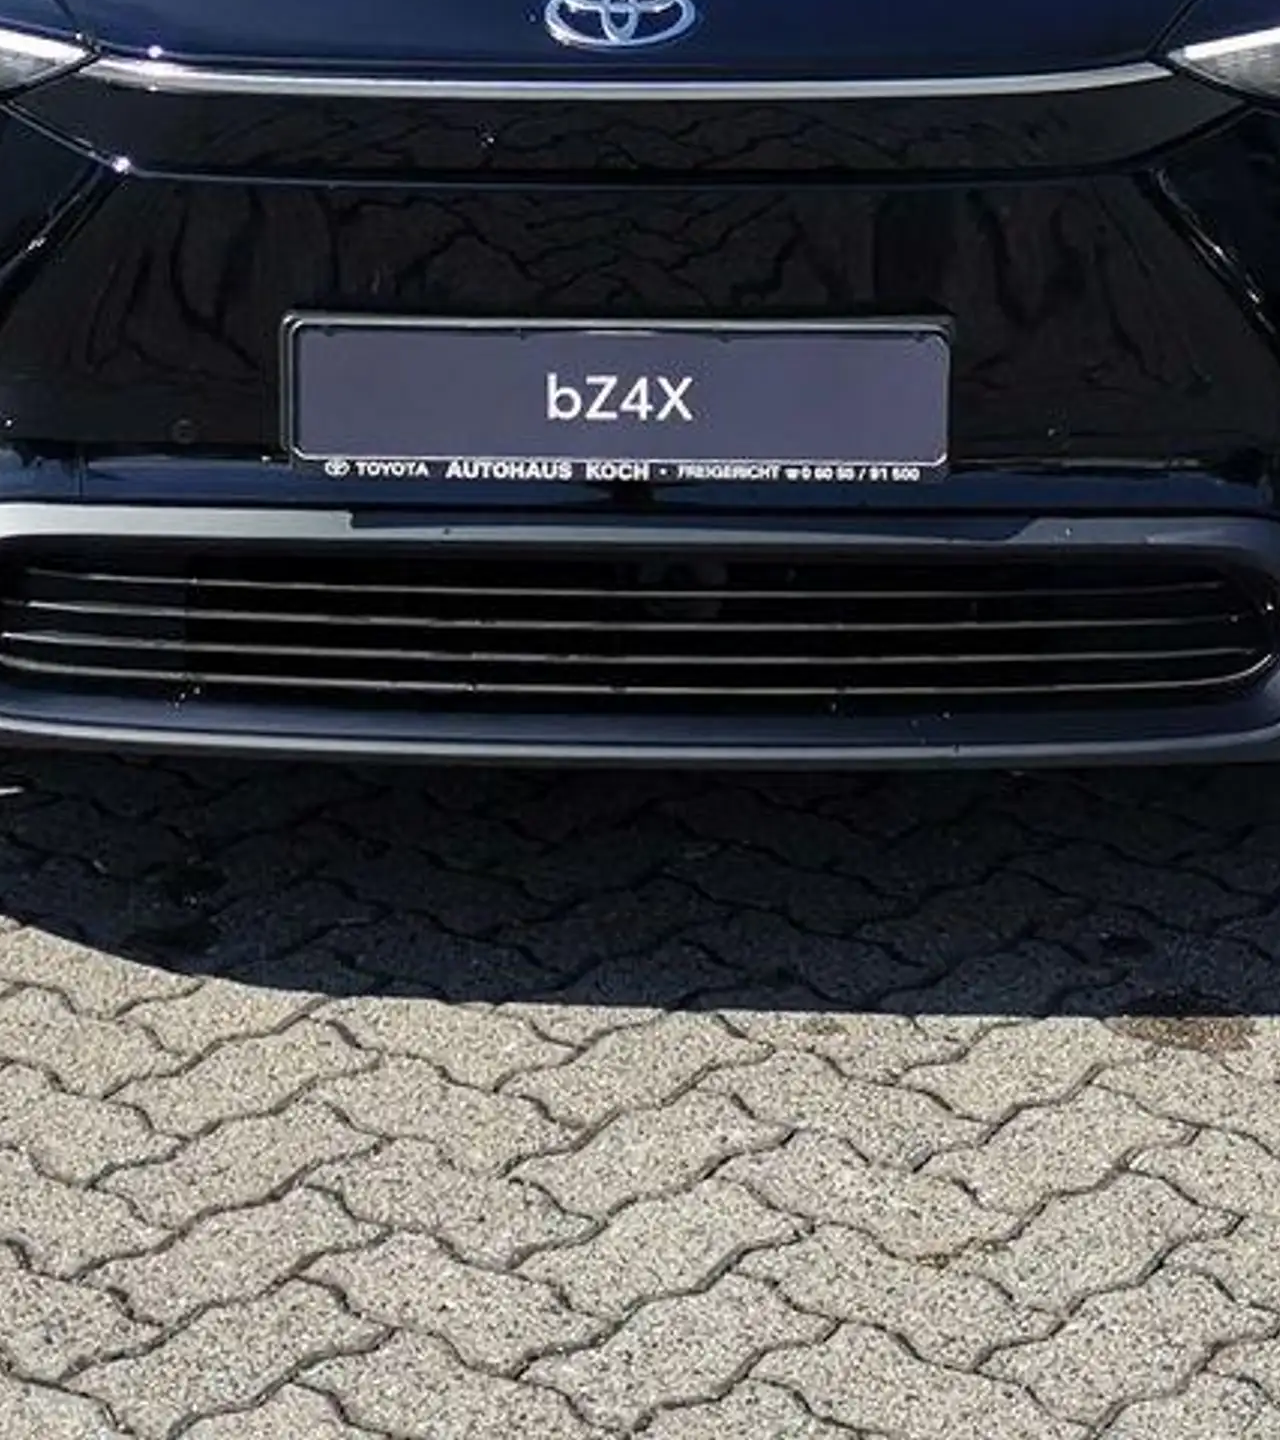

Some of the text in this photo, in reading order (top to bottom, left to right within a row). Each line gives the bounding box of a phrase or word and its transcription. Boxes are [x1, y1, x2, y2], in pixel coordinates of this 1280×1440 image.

[546, 372, 693, 421] bZ4X
[355, 462, 429, 477] TOYOTA
[445, 460, 573, 480] AUTOHAUS
[586, 461, 649, 481] KOCH
